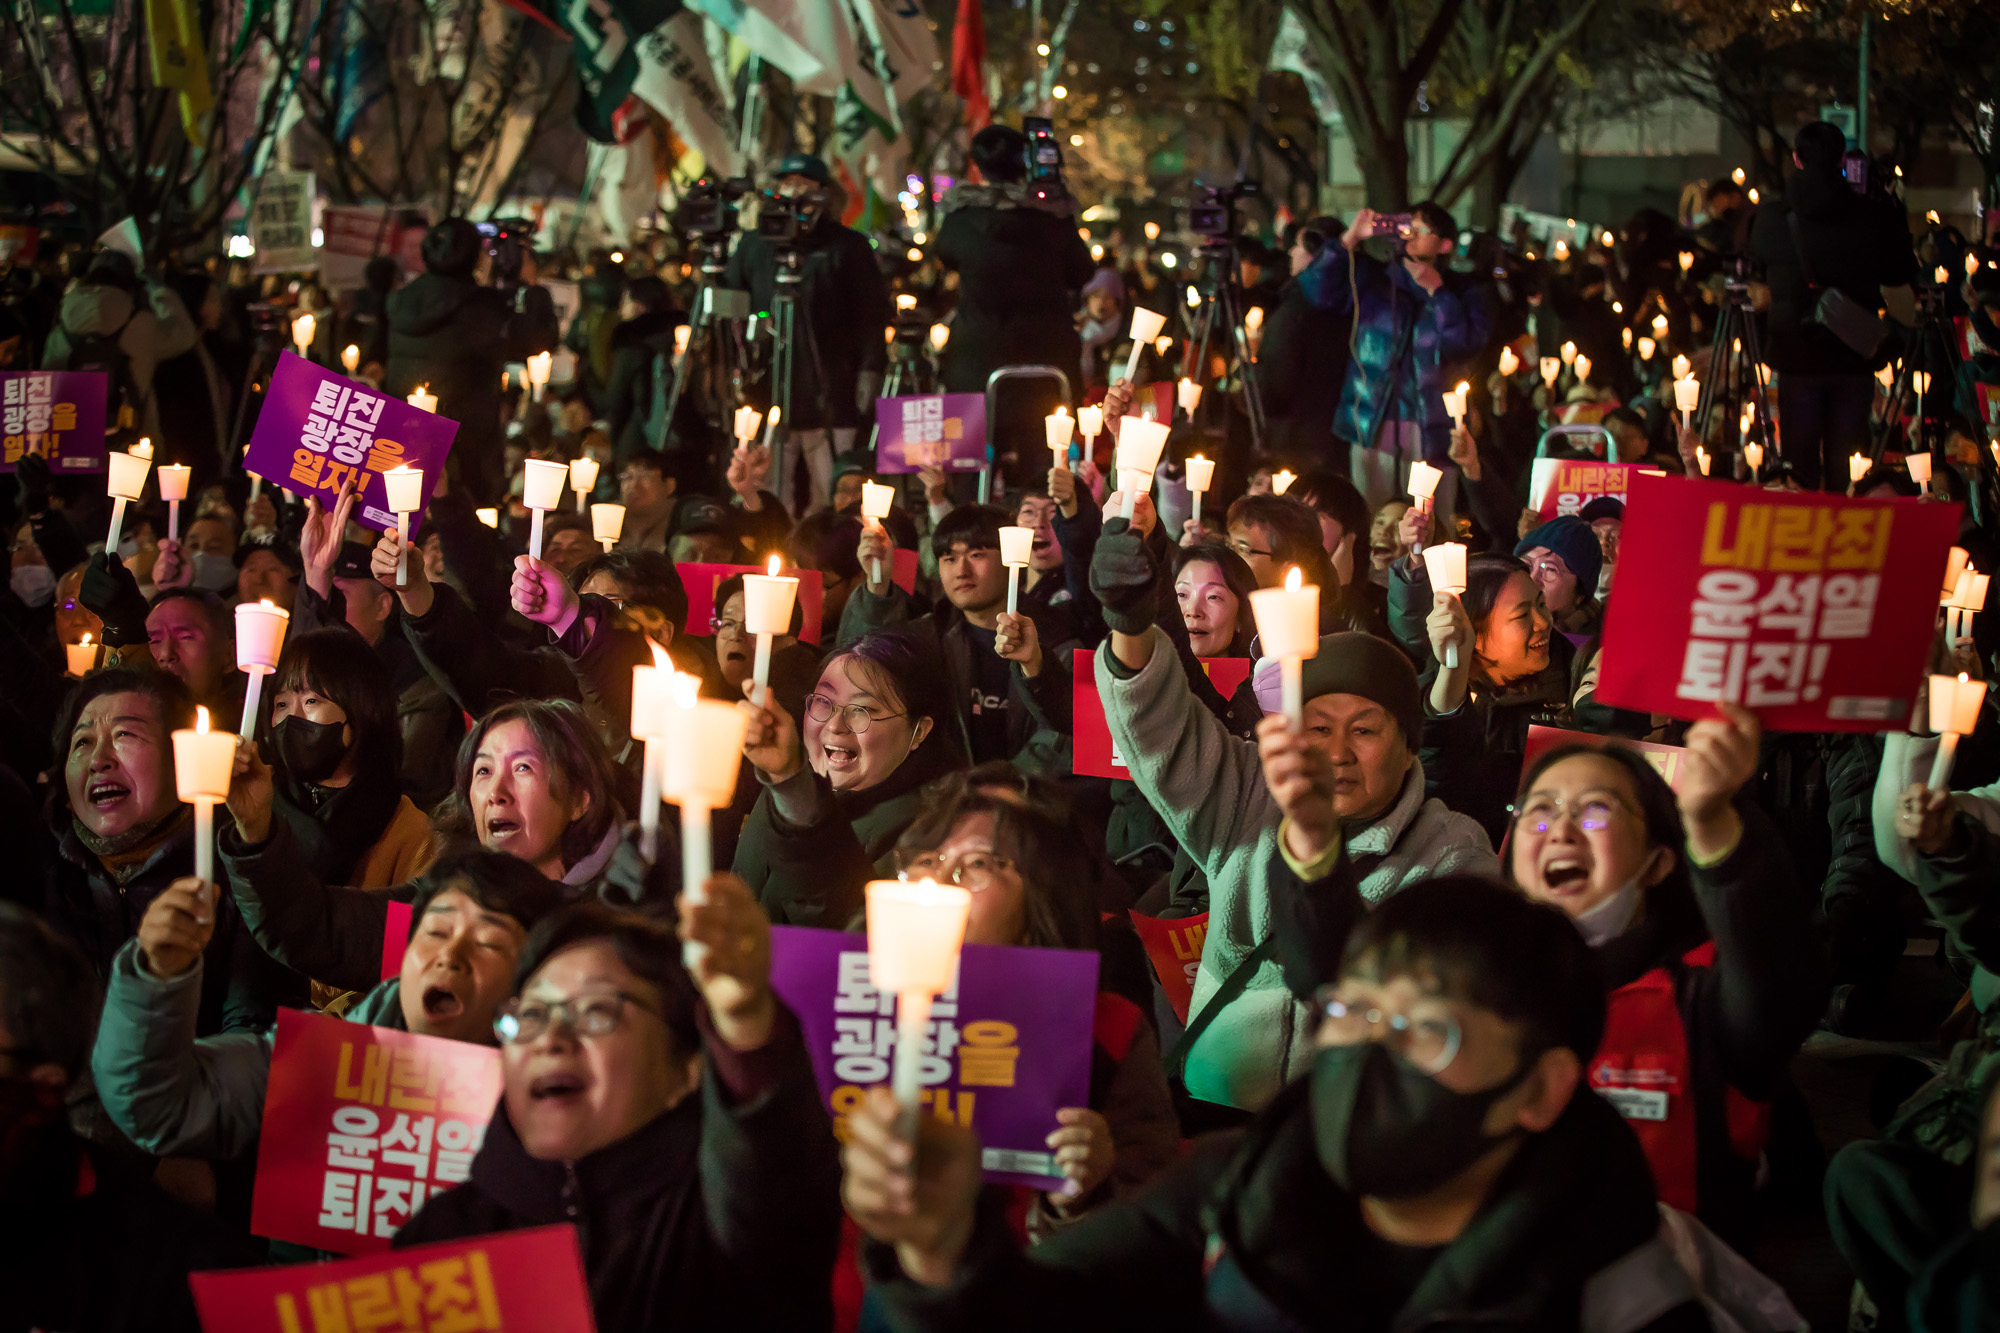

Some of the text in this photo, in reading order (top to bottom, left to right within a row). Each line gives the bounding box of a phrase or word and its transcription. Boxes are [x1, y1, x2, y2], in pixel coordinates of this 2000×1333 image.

[3, 375, 52, 406] 퇴진
[3, 402, 78, 434] 광장을
[310, 379, 386, 433] 퇴진
[289, 448, 372, 502] 열자!
[300, 412, 405, 474] 광장을
[1558, 466, 1629, 493] 내란죄
[1700, 501, 1895, 572] 내란죄
[1689, 570, 1882, 640] 윤석열
[1676, 638, 1832, 708] 퇴진!
[832, 1020, 1020, 1087] 광장을
[327, 1105, 488, 1183] 윤석열
[318, 1170, 447, 1239] 퇴진
